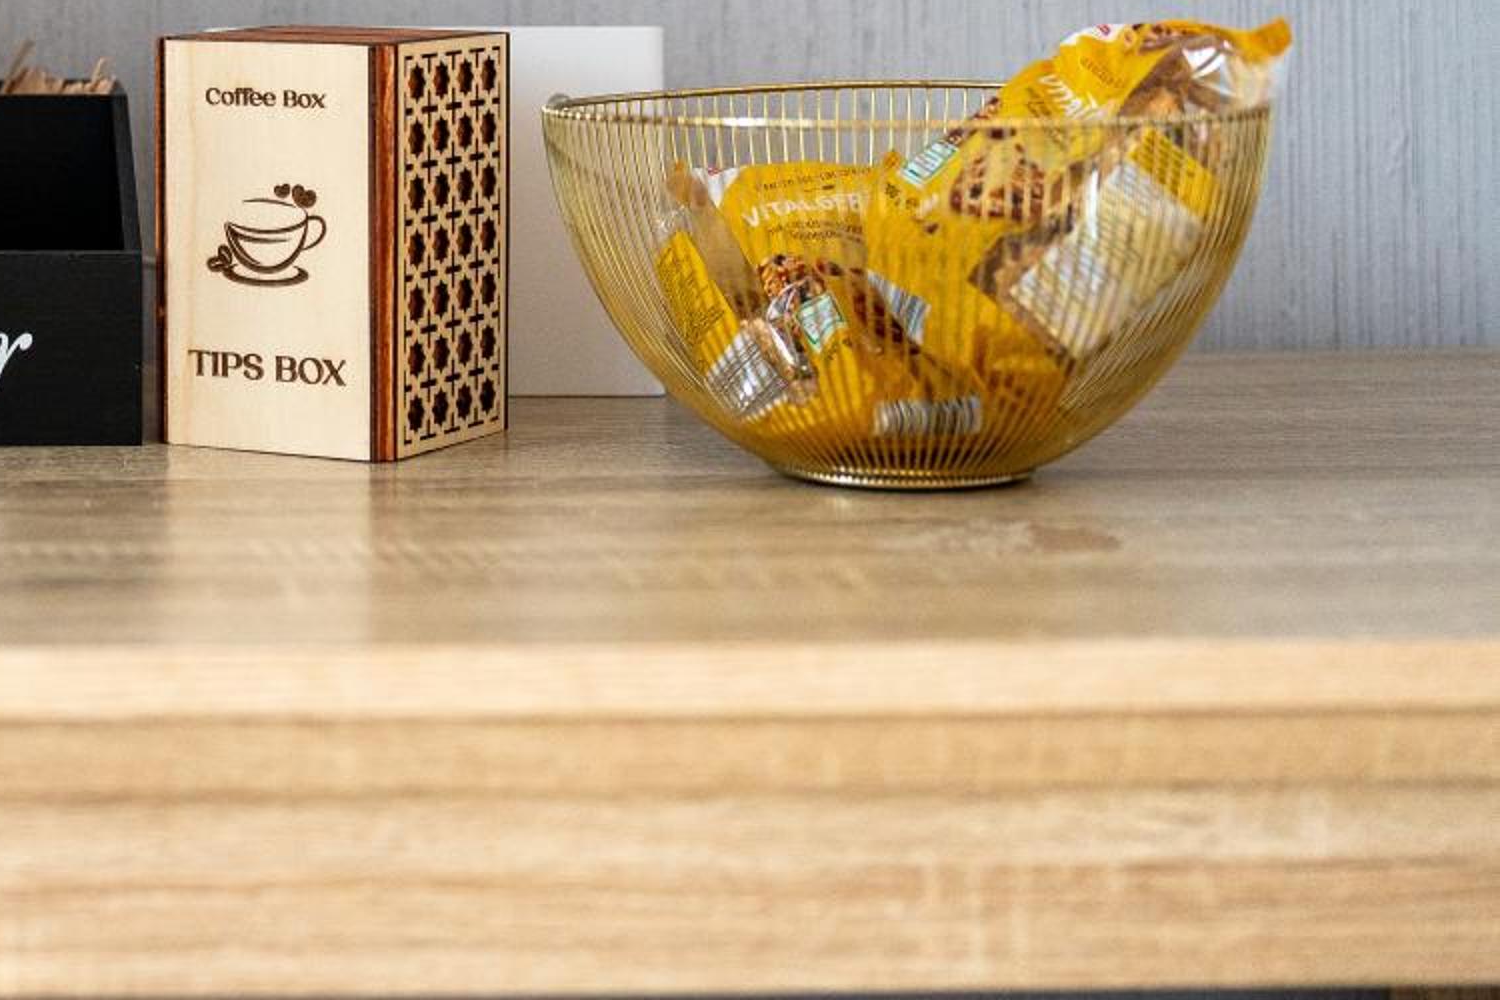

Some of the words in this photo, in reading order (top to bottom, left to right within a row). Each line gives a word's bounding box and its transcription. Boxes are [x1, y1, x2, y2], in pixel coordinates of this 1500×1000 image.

[205, 87, 277, 107] Coffee
[283, 89, 326, 109] Box
[187, 349, 265, 381] TIPS
[275, 355, 347, 387] BOX
